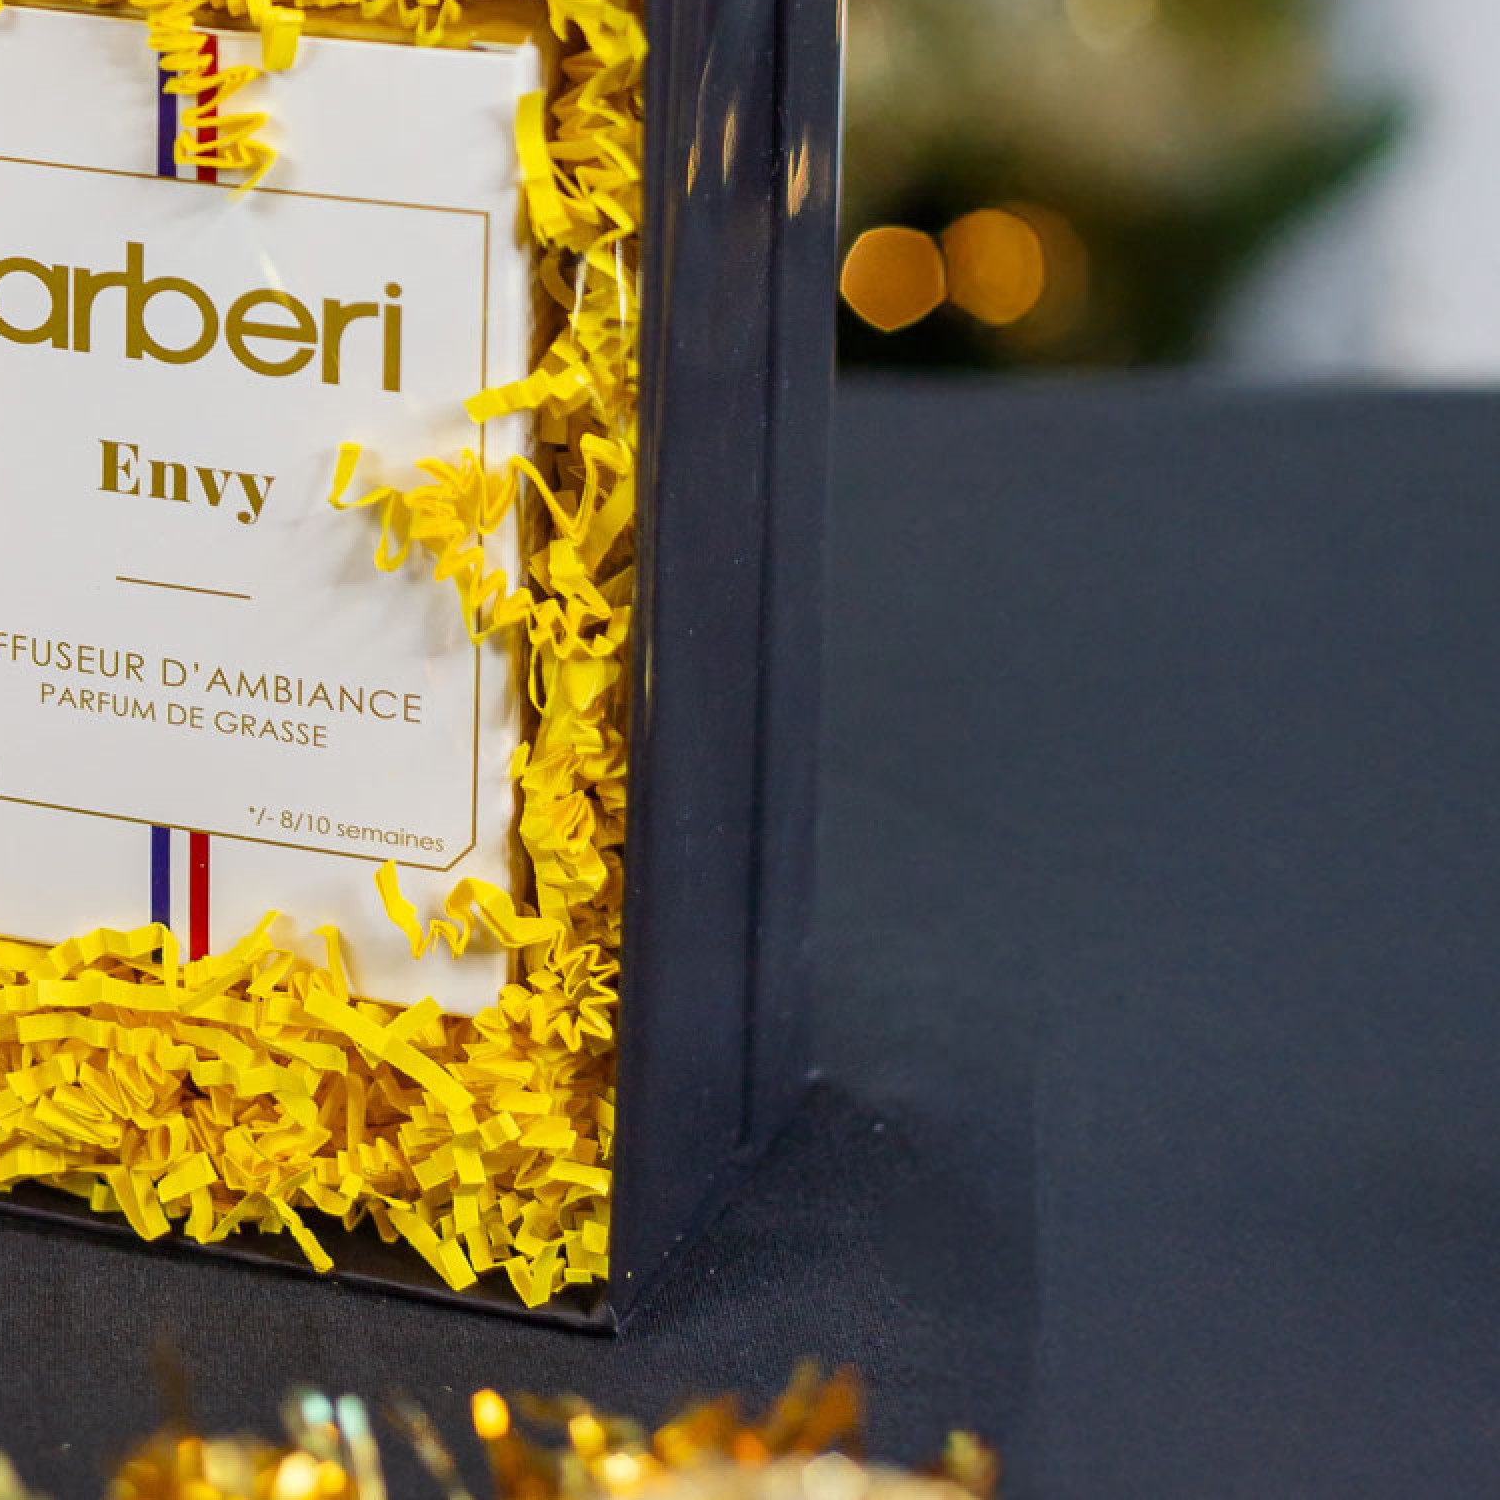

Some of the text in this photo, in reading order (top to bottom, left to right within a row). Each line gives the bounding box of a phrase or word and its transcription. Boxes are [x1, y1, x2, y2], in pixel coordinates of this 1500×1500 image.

[97, 439, 275, 524] Envy
[41, 682, 328, 749] PARFUM DE GRASSE
[161, 657, 422, 724] D'AMBIANCE
[280, 809, 330, 835] 8/10
[336, 823, 445, 853] semaines
